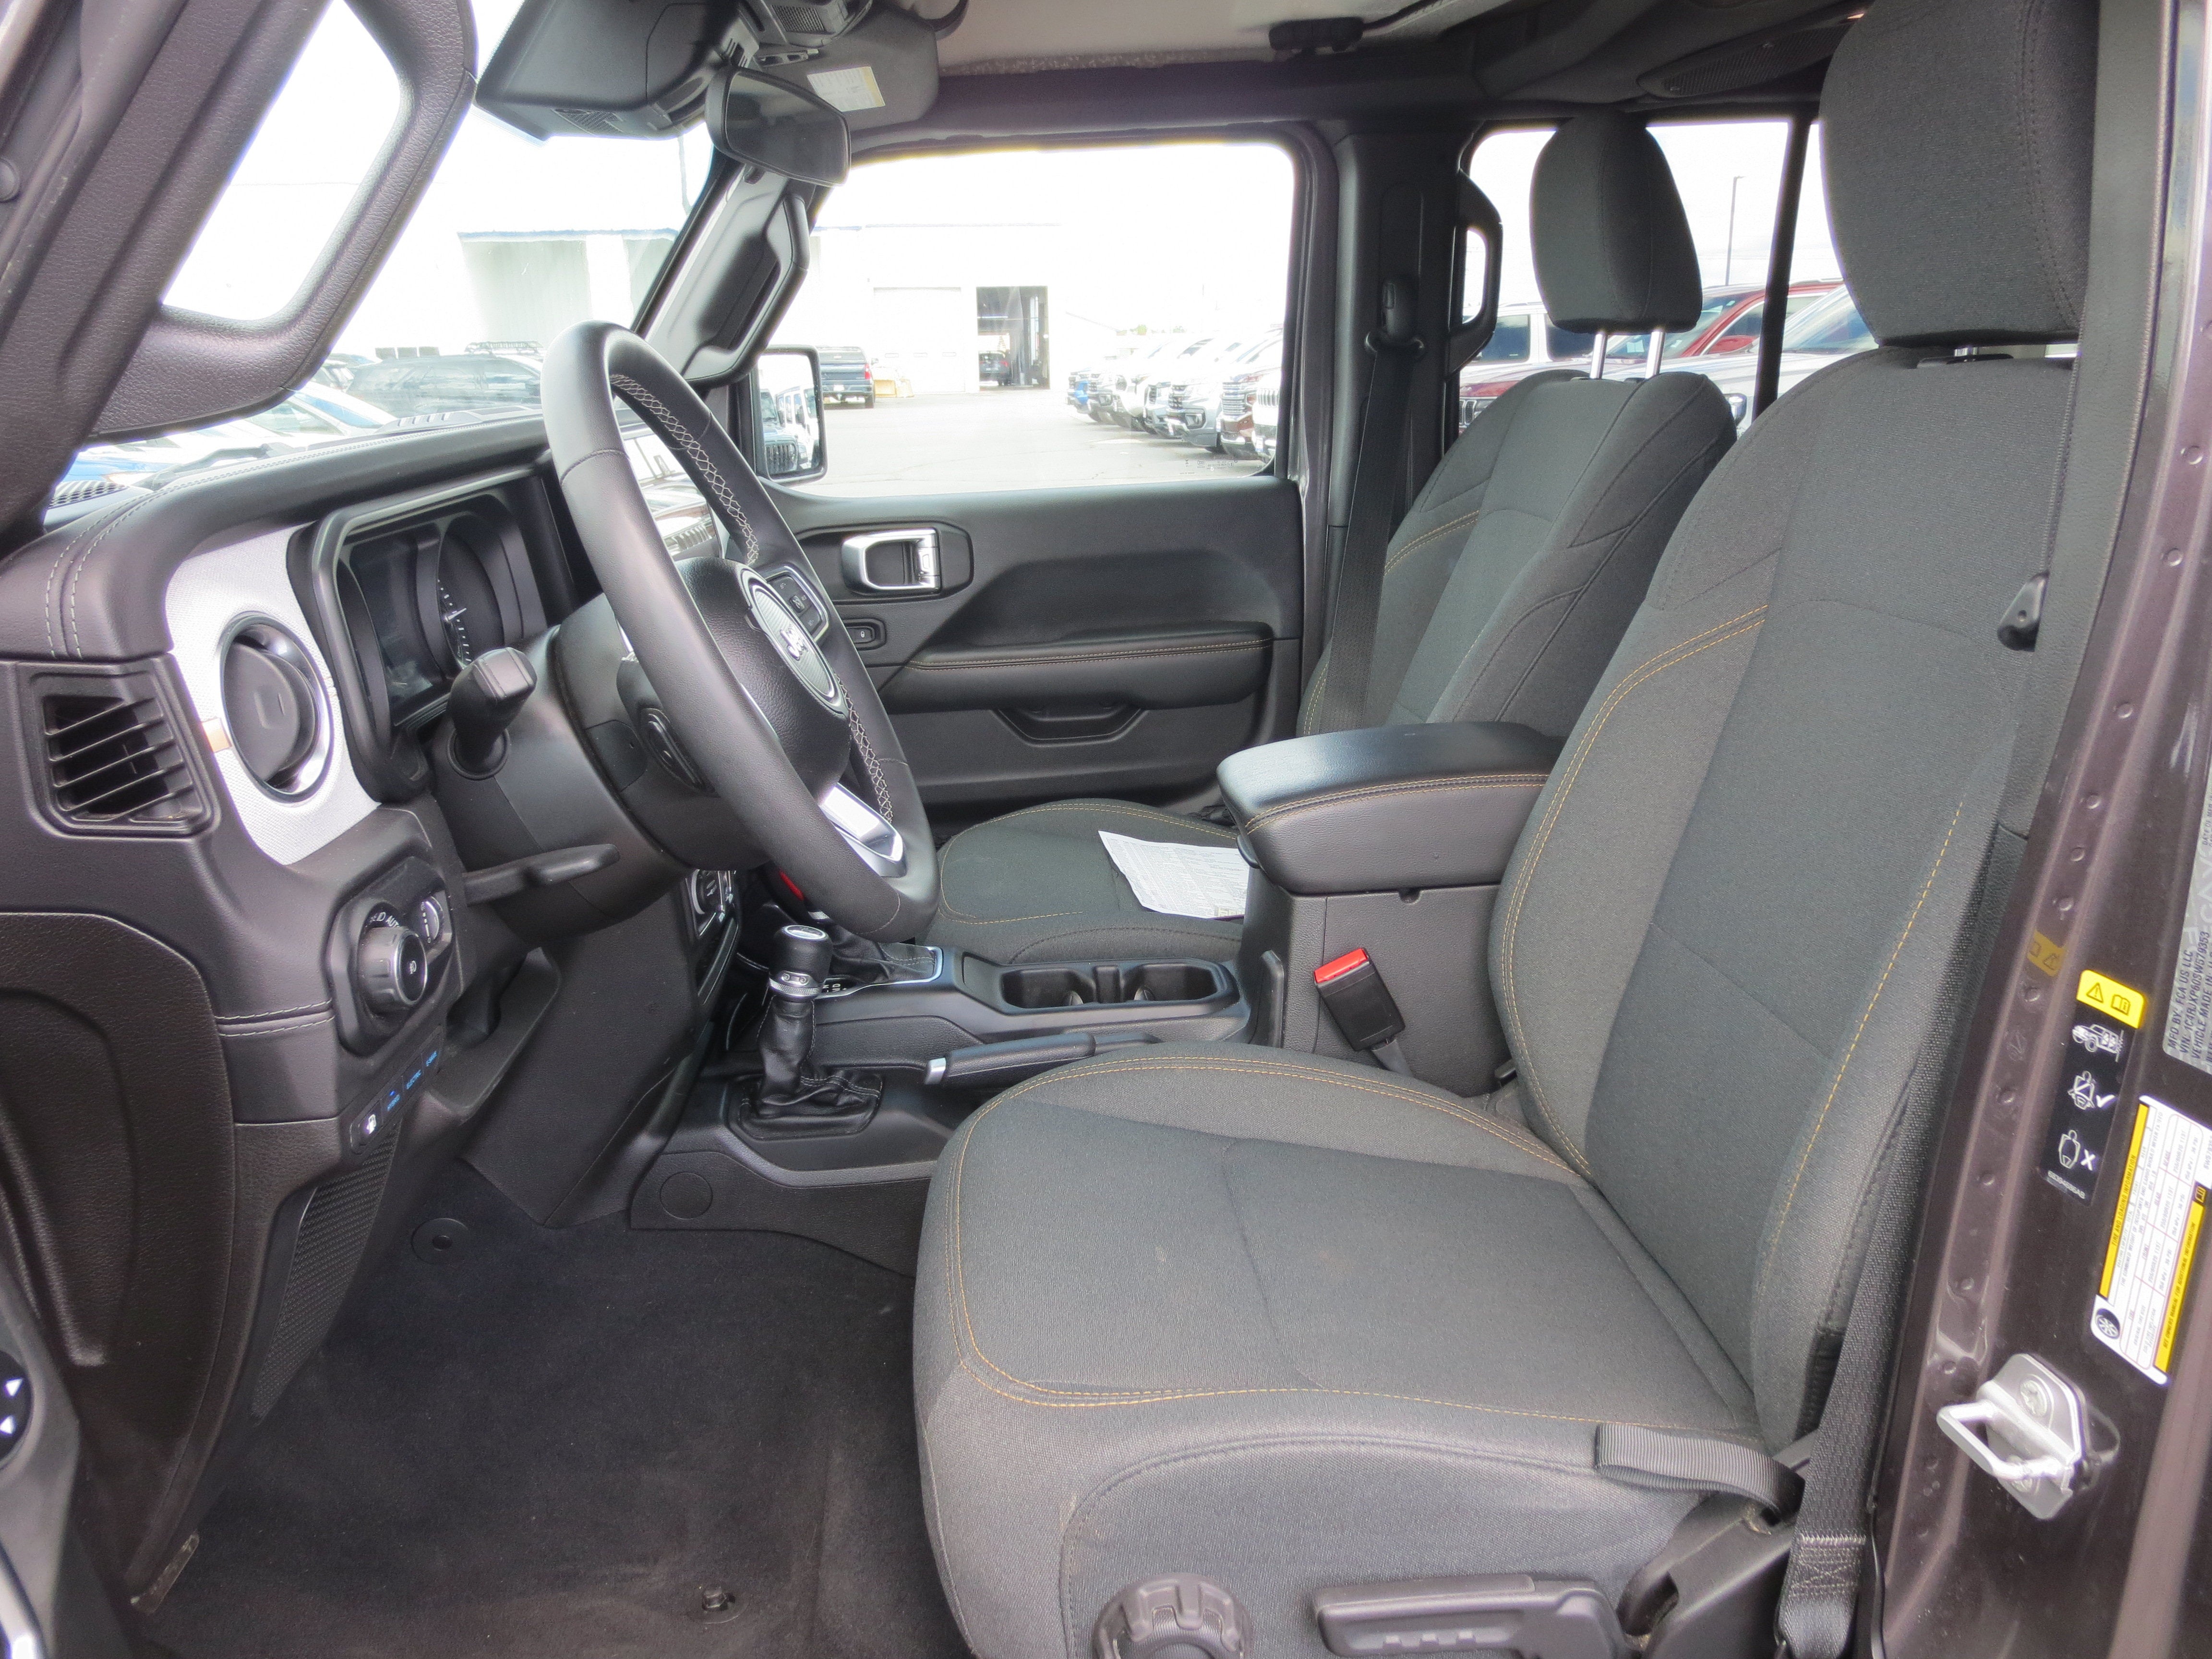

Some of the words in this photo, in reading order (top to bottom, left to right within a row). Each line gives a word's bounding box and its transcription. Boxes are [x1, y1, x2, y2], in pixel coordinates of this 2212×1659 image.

[385, 915, 400, 928] AUT
[2182, 950, 2193, 968] LLC
[2179, 970, 2189, 984] US
[2176, 986, 2187, 1005] FCA
[2172, 1009, 2183, 1024] BY:
[2192, 1021, 2206, 1059] VEHICLE
[2200, 989, 2212, 1018] MADE
[2167, 1026, 2179, 1049] MFD
[2179, 1035, 2191, 1054] VIN:
[2117, 1193, 2128, 1220] LOADING
[2123, 1154, 2136, 1194] INFORMATION
